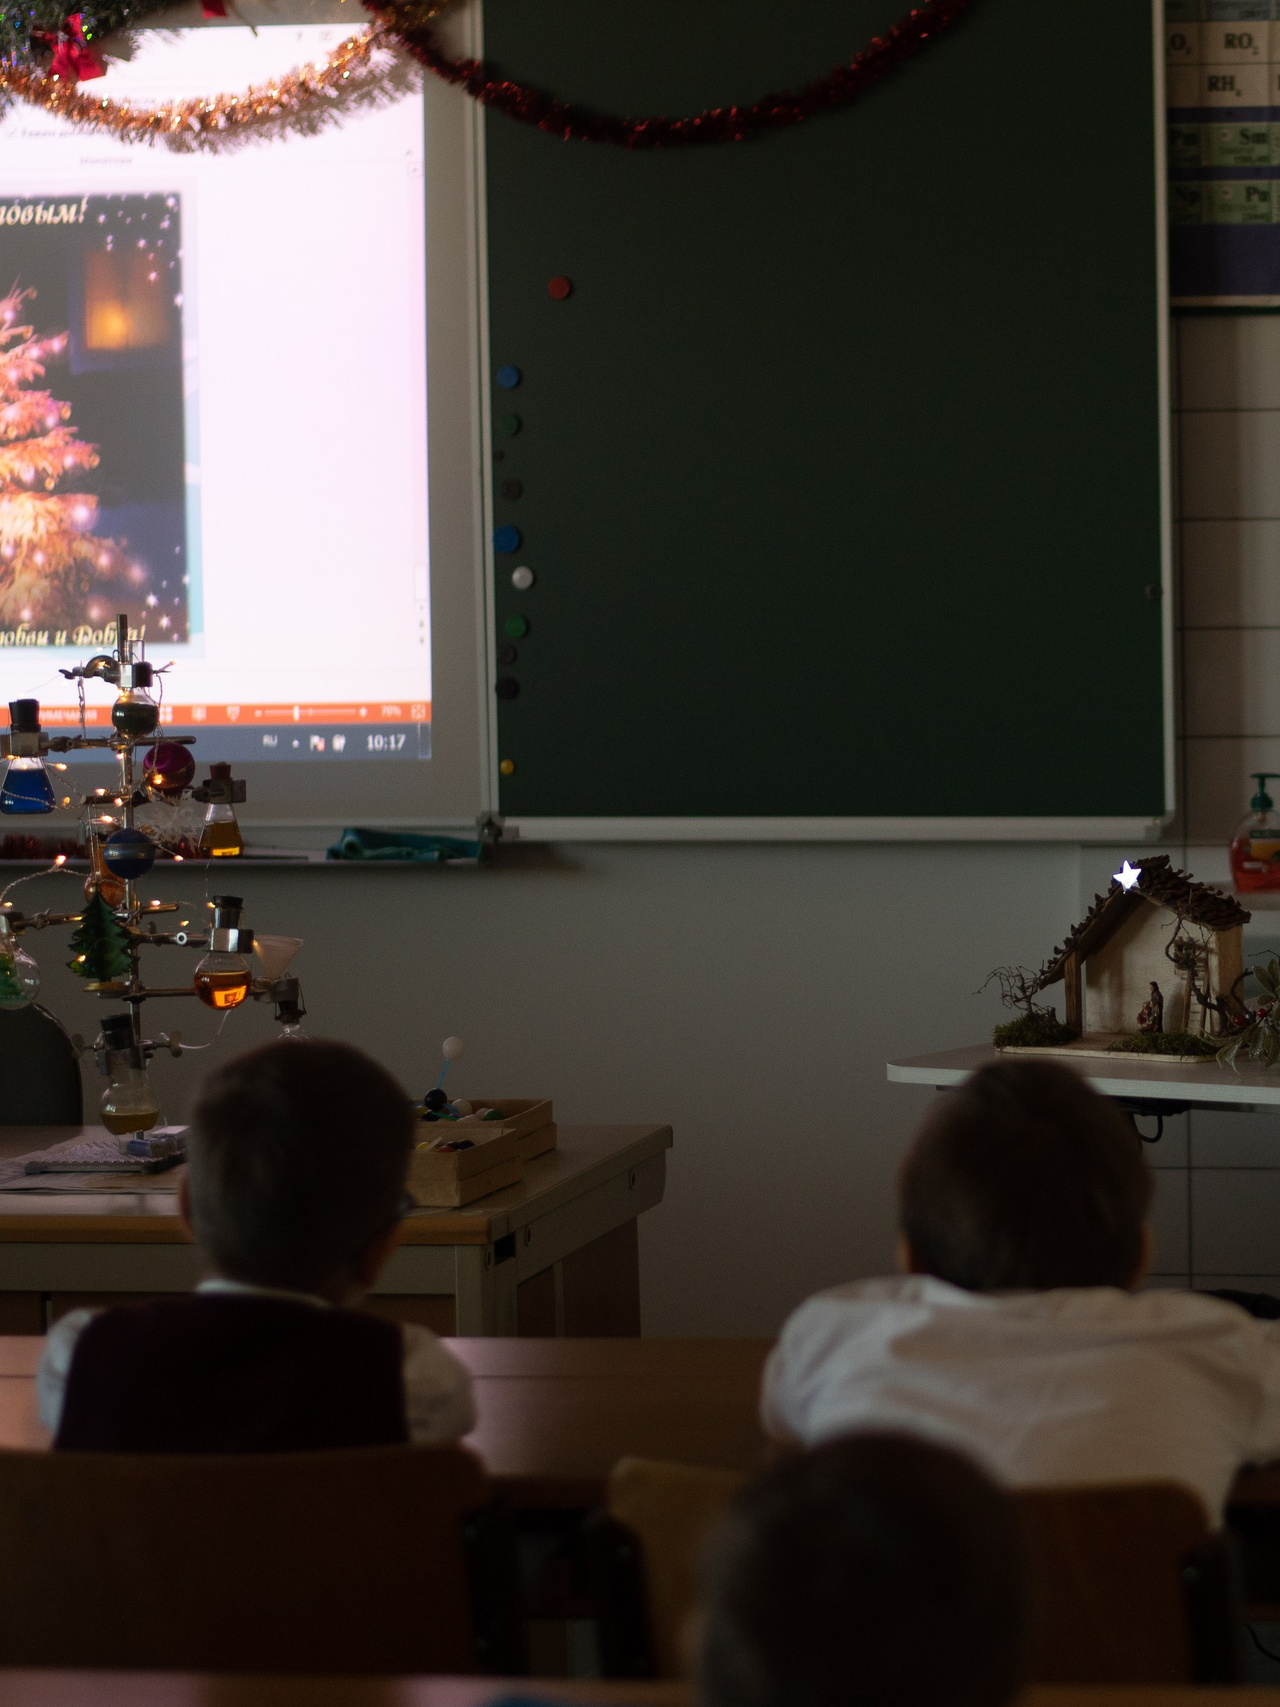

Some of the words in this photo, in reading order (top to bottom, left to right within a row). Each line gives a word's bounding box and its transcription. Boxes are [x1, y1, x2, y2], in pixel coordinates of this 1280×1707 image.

[1239, 128, 1266, 144] Sm
[55, 630, 67, 647] и
[367, 734, 406, 751] 10:17
